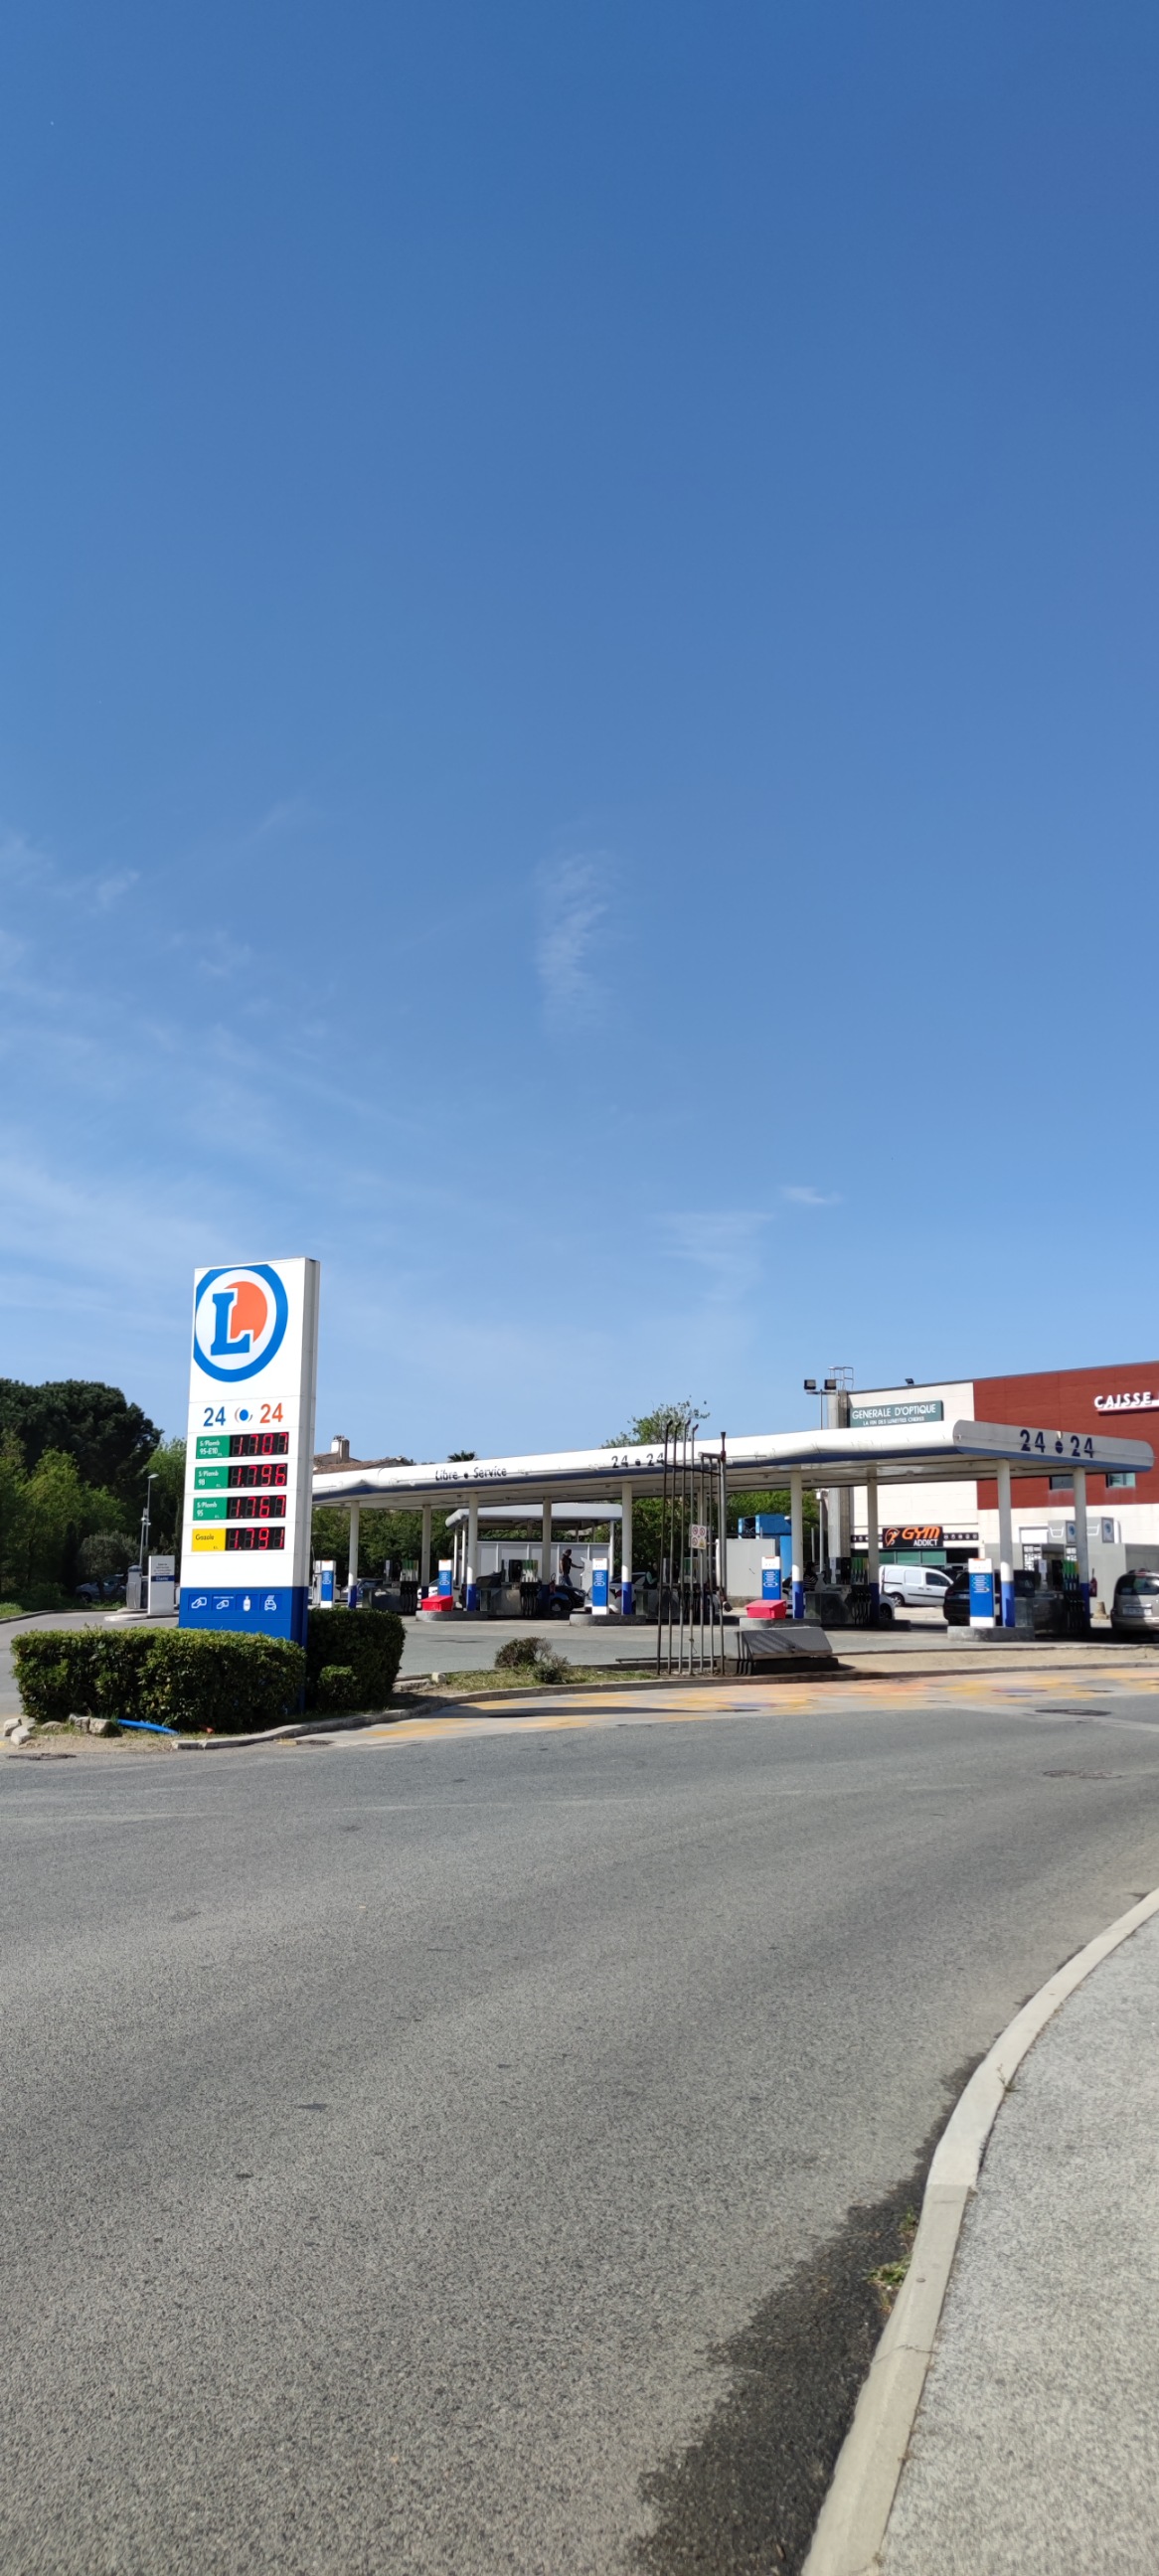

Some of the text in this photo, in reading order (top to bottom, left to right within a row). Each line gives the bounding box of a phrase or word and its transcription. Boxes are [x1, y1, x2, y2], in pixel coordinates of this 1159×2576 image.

[211, 1292, 250, 1356] L
[1094, 1391, 1152, 1409] CAISSE
[203, 1402, 284, 1427] 24 24
[852, 1403, 936, 1420] GENERALE D'OPTIQUE
[239, 1432, 288, 1456] 1.707
[1020, 1429, 1095, 1458] 24 24
[611, 1452, 665, 1468] 24 24
[238, 1464, 286, 1487] 1.796
[435, 1465, 507, 1481] Libre Service
[236, 1496, 285, 1519] 1.767
[234, 1528, 284, 1550] 1.791
[902, 1526, 940, 1540] GYM
[912, 1538, 938, 1547] ADDICT
